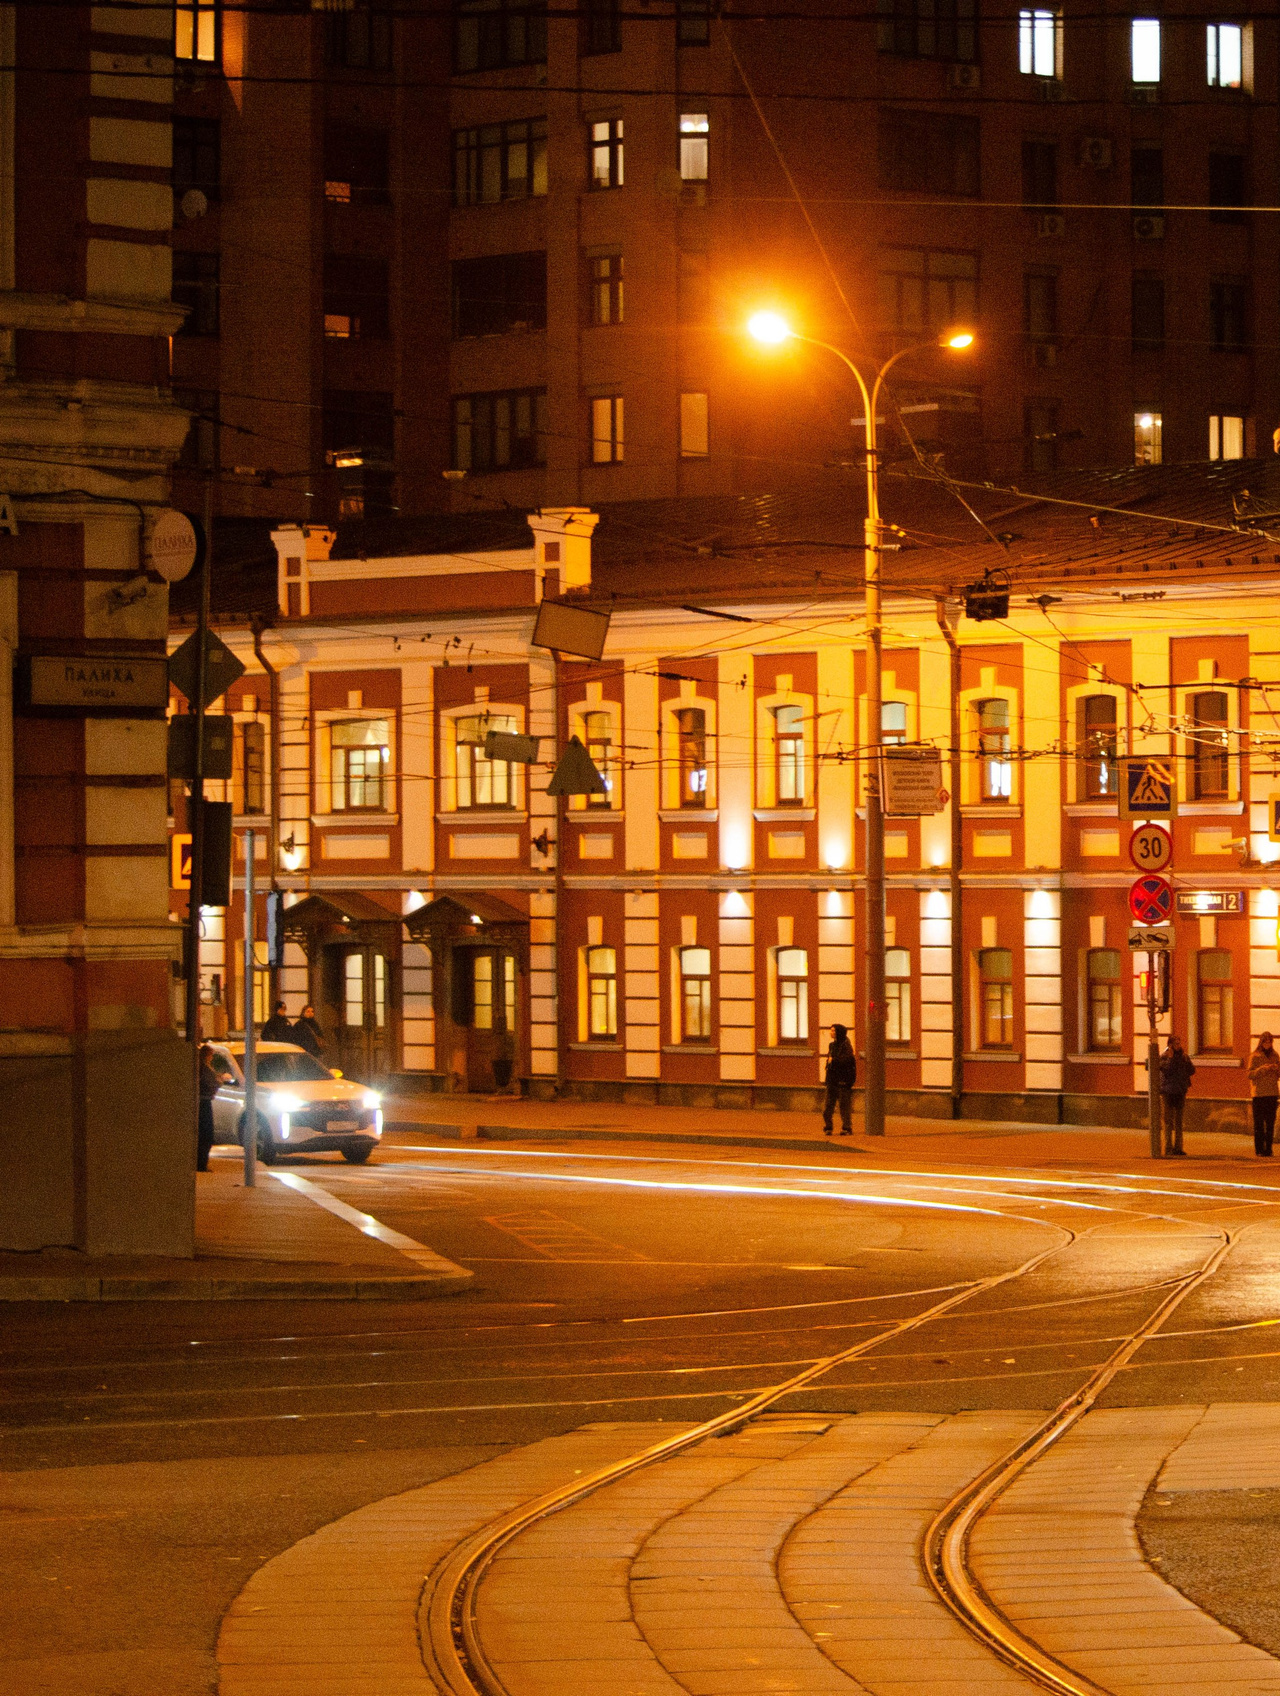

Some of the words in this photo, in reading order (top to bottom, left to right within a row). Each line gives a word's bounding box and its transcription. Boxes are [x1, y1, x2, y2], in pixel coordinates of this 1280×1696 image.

[64, 666, 134, 683] ПАЛИХА
[1139, 836, 1162, 859] 30
[1228, 894, 1237, 910] 2
